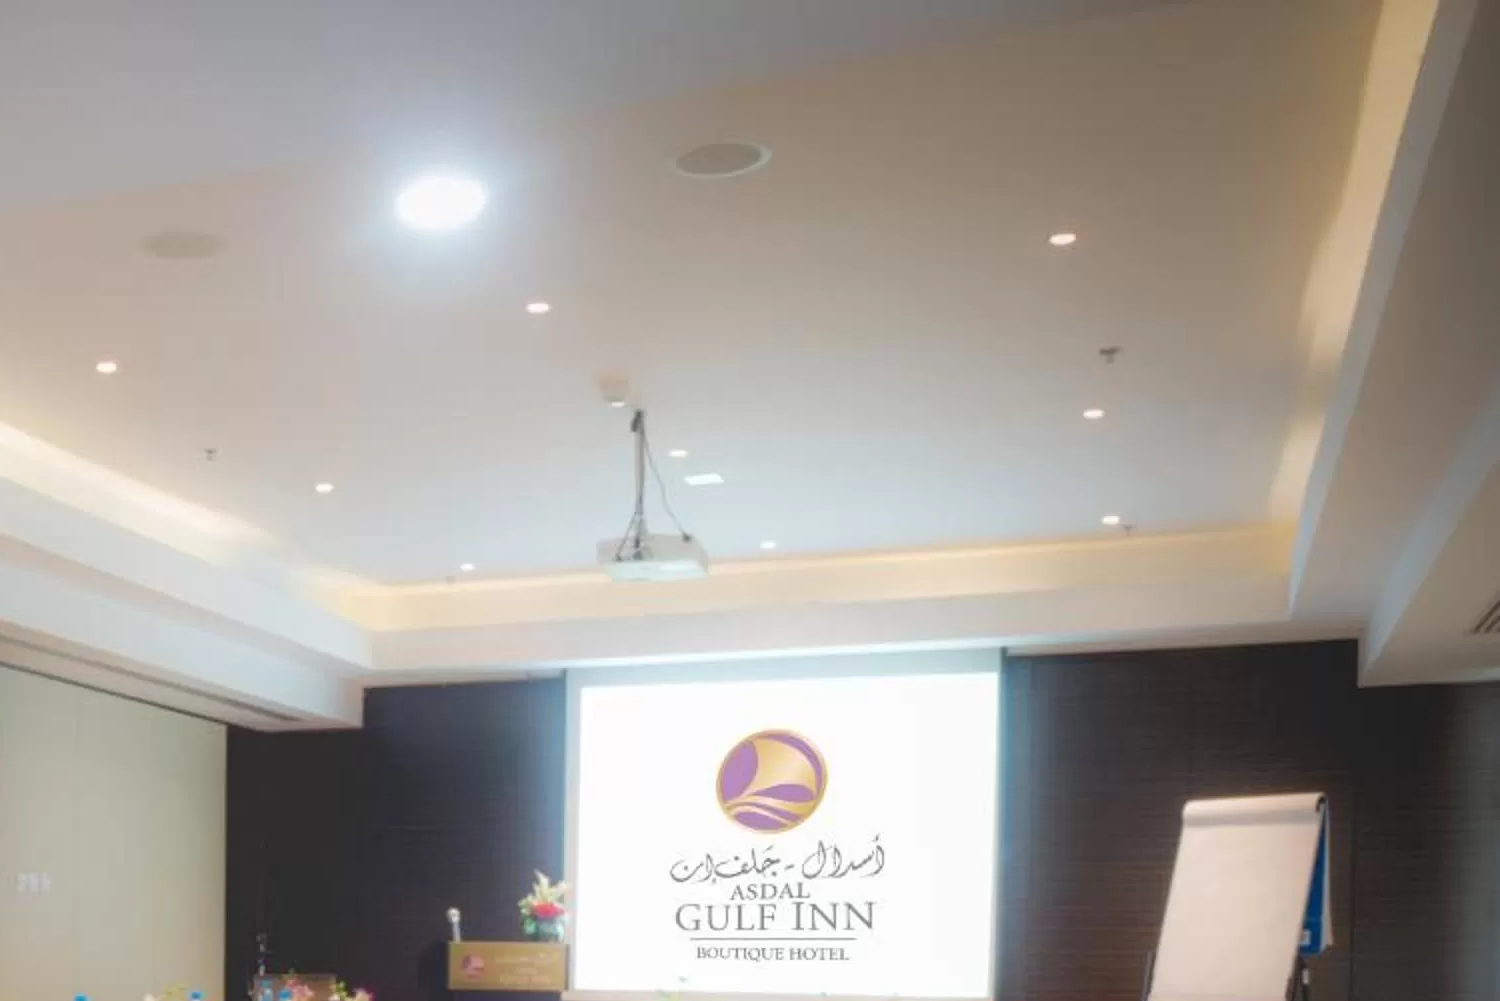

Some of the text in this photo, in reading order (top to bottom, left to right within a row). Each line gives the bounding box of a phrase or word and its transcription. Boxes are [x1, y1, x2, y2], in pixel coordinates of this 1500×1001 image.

[730, 882, 811, 901] ASDAL
[675, 901, 876, 932] GULF INN
[696, 946, 850, 963] BOUTIQUE HOTEL
